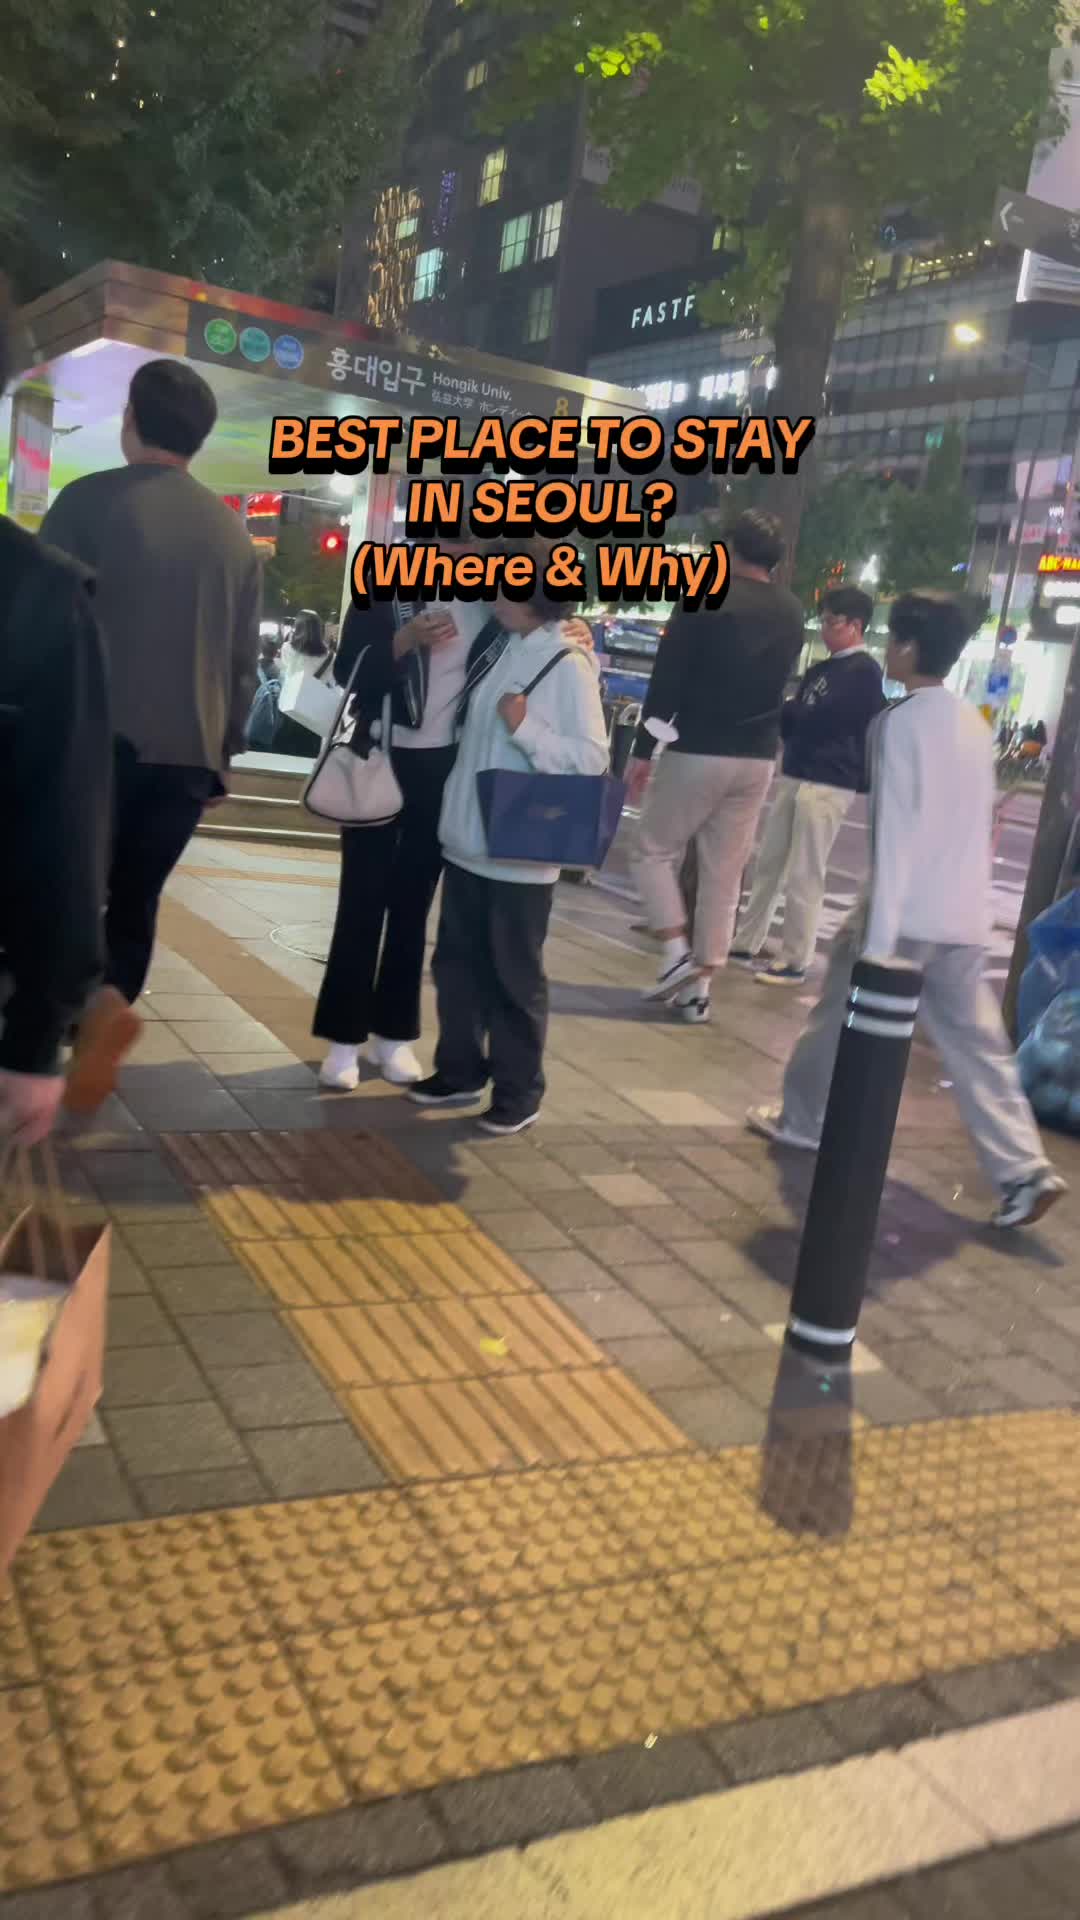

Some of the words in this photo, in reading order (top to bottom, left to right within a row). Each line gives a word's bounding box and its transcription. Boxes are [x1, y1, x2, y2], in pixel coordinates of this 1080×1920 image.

[325, 346, 428, 397] 홍대입구
[432, 370, 479, 394] Hongik
[480, 382, 513, 402] Univ.
[551, 392, 570, 417] 8
